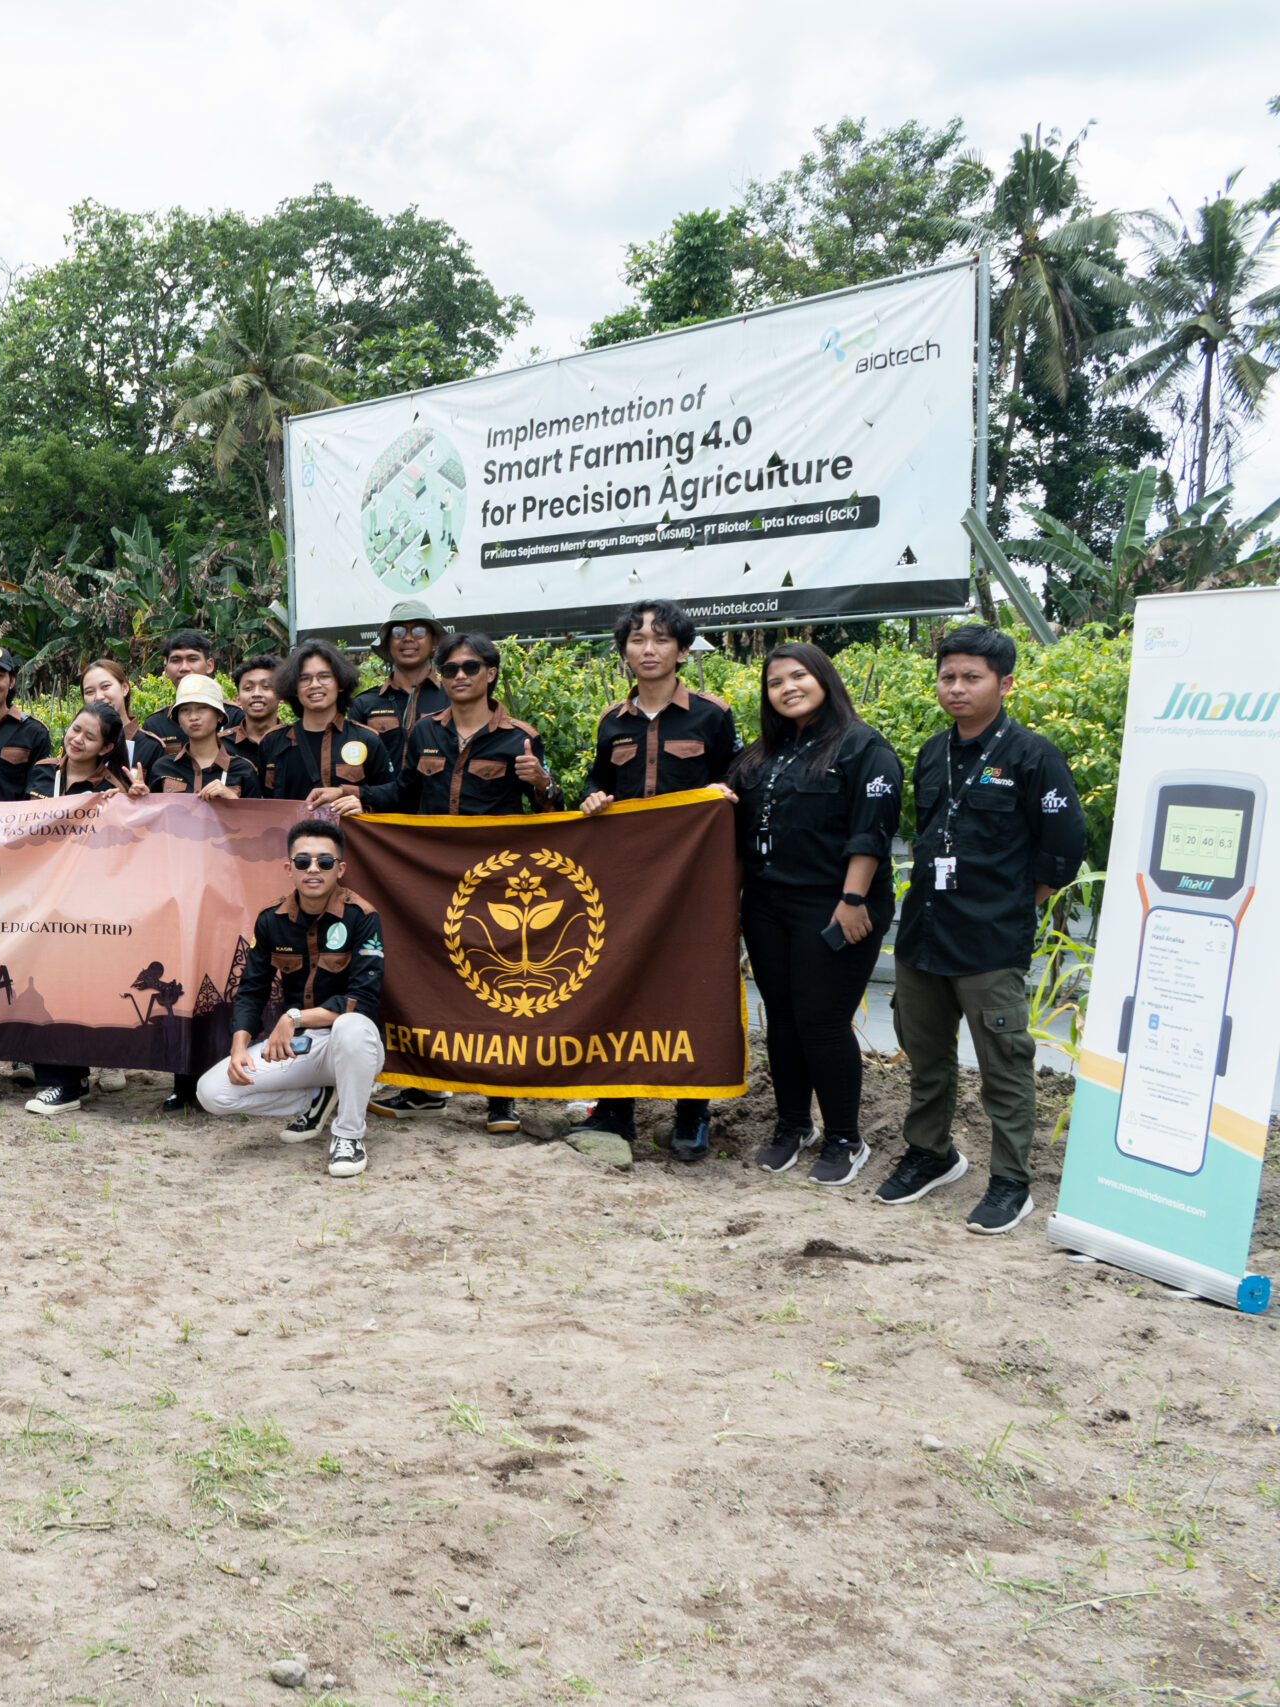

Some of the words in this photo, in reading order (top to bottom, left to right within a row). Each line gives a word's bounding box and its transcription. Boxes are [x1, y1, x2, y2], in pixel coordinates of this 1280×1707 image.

[855, 338, 941, 374] Biotech
[486, 394, 674, 451] Implementation
[679, 382, 708, 412] of
[483, 448, 564, 485] Smart
[569, 428, 695, 472] Farming
[700, 415, 753, 450] 4.0
[481, 498, 517, 528] for
[522, 480, 652, 523] Precision
[495, 547, 517, 560] Mitra
[517, 544, 560, 558] Sejahtera
[620, 532, 656, 546] Bangsa
[657, 523, 696, 543] (MSMB)
[704, 525, 716, 537] PT
[753, 516, 785, 532] ipta
[786, 510, 824, 527] Kreasi
[825, 505, 861, 524] (BCK)
[682, 598, 780, 618] www.biotek.co.id
[28, 823, 98, 837] UDAYANA
[1186, 835, 1197, 845] 20
[1202, 837, 1215, 847] 40
[1, 920, 88, 935] EDUCATION
[89, 922, 133, 937] TRIP)
[384, 1021, 528, 1066] ERTANIAN
[535, 1029, 695, 1067] UDAYANA
